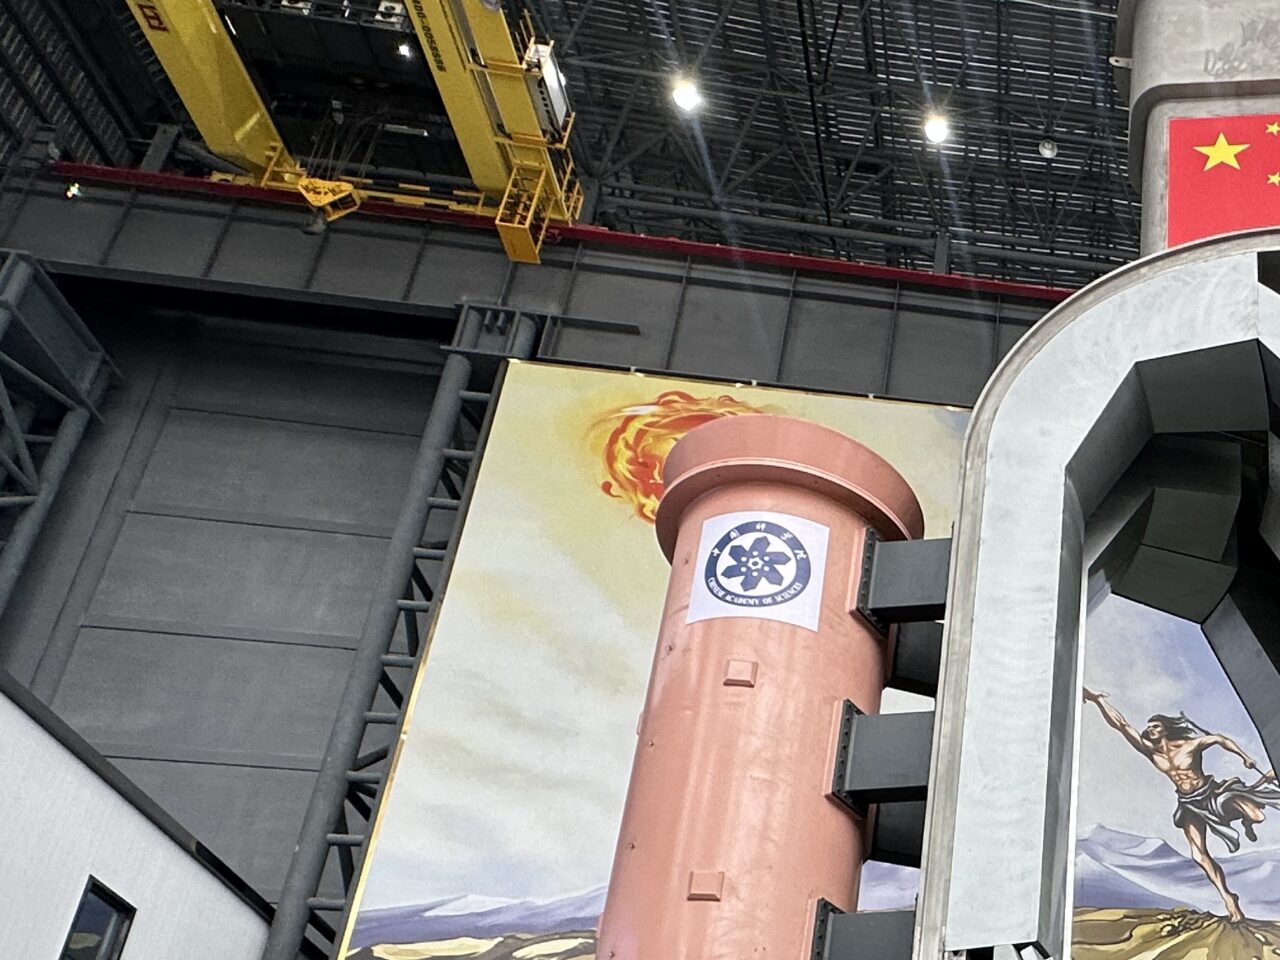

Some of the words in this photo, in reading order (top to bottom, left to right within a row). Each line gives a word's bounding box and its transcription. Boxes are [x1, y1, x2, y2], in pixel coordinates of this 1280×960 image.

[726, 596, 759, 605] ACADEMY
[762, 596, 773, 605] OF
[774, 581, 803, 602] SCIENCES
